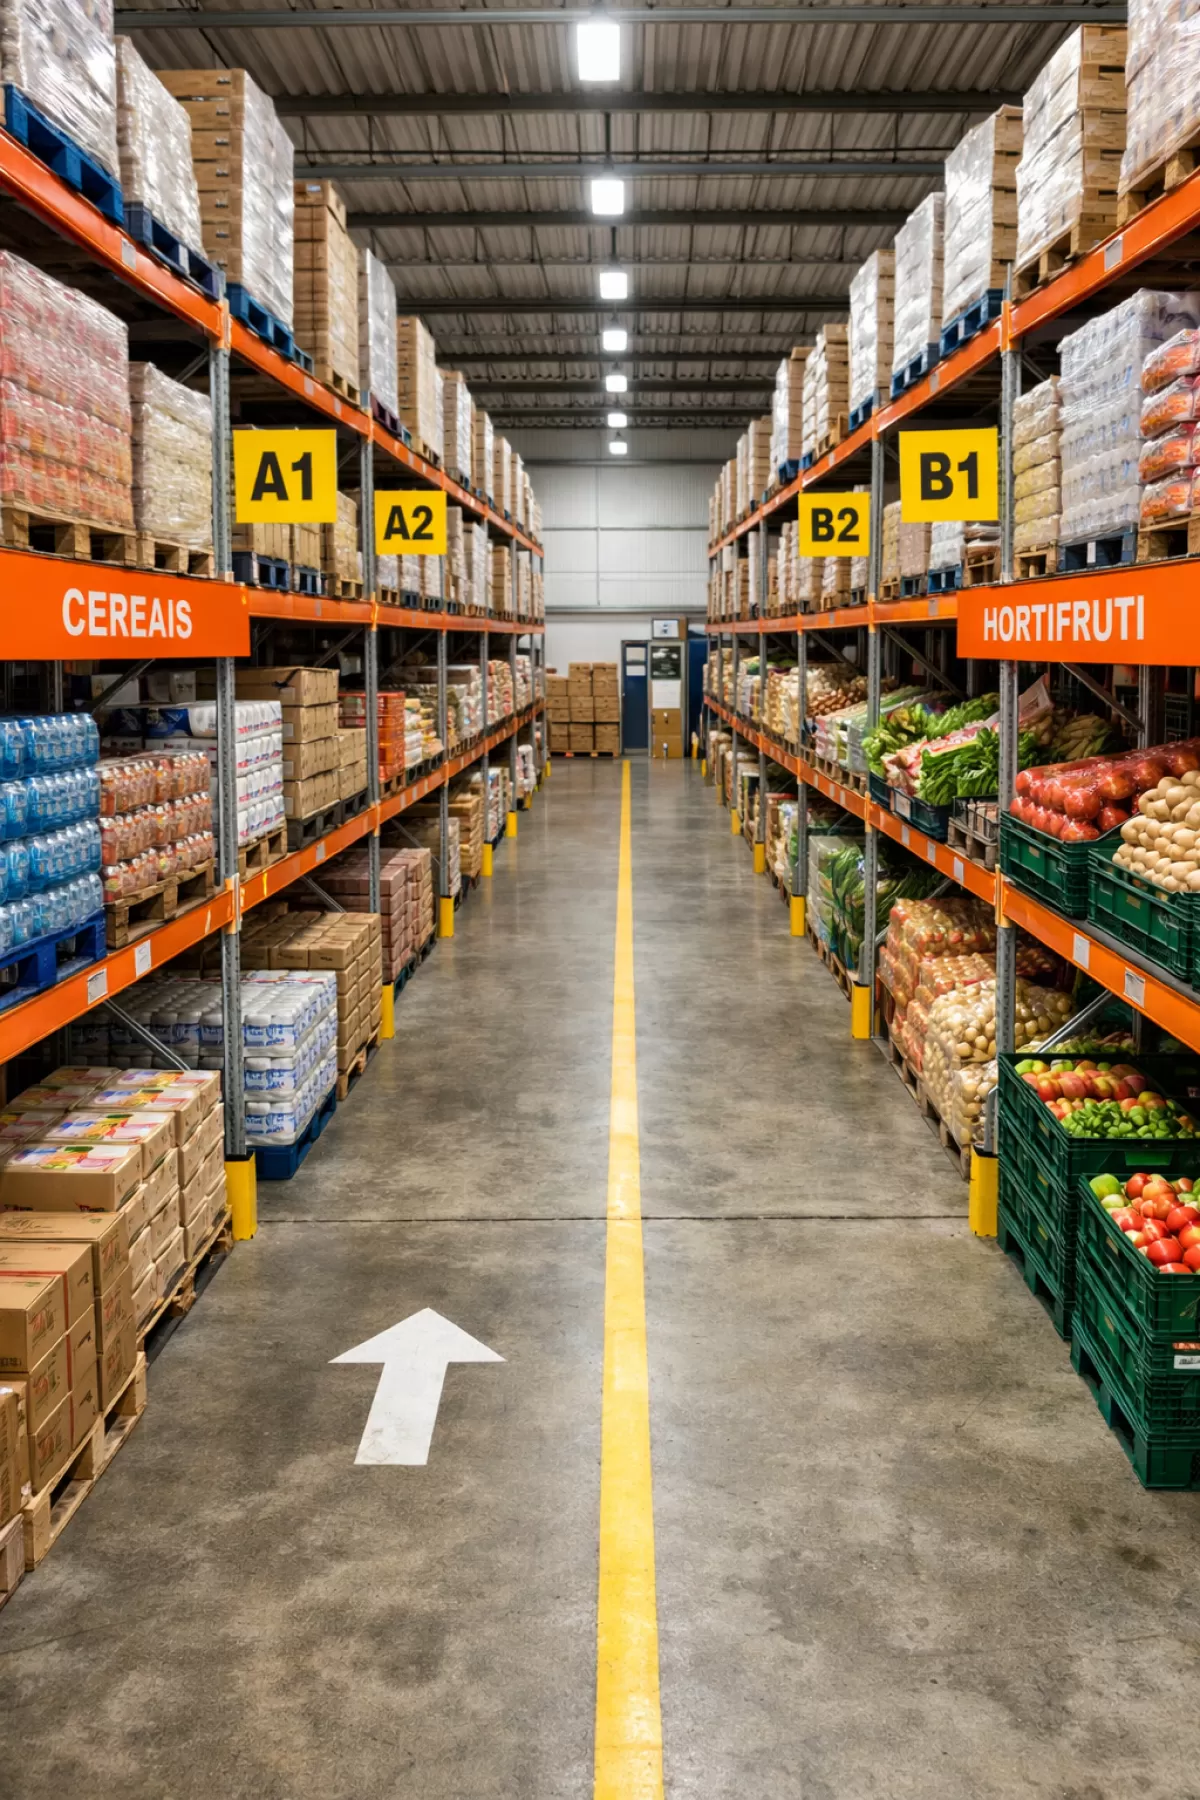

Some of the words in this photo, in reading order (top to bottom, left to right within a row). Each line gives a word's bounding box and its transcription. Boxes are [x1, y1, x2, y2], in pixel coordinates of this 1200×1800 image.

[251, 451, 313, 501] A1
[920, 451, 978, 500] B1
[383, 505, 433, 540] A2
[811, 507, 860, 541] B2
[62, 588, 193, 639] CEREAIS
[984, 595, 1145, 642] HORTIFRUTI
